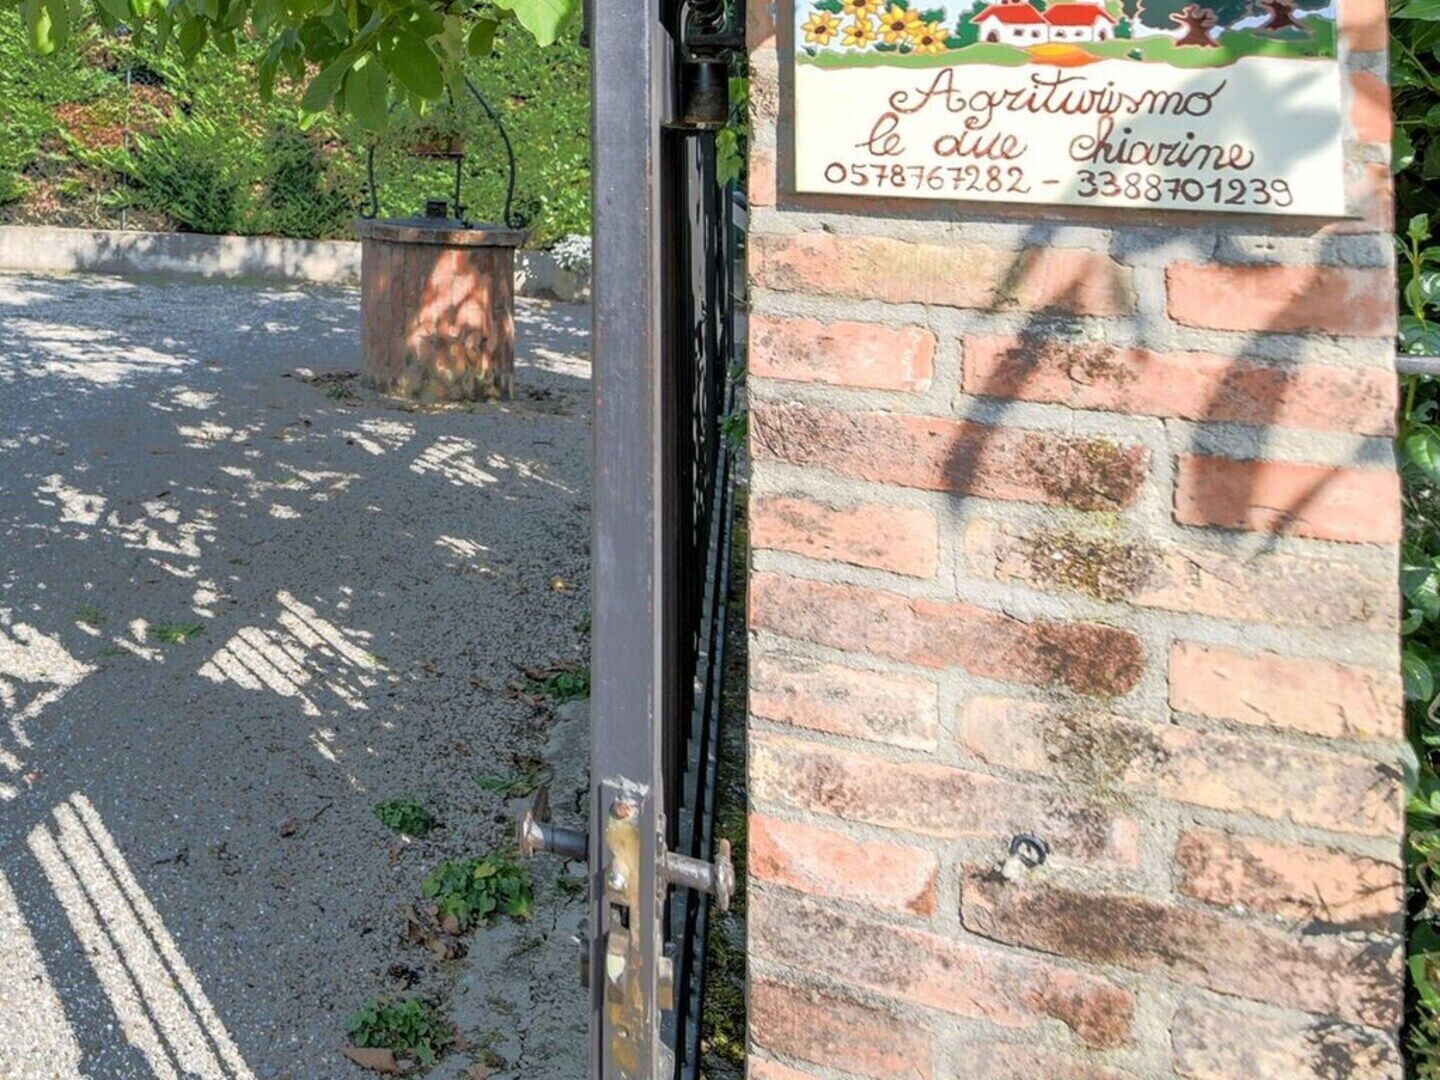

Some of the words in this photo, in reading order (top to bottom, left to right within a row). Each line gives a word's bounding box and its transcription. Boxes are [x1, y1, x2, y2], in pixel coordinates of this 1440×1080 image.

[888, 67, 1228, 131] Agriturismo
[933, 130, 1029, 161] due
[823, 161, 1032, 194] 0578767282
[1076, 168, 1294, 208] 3388701239
